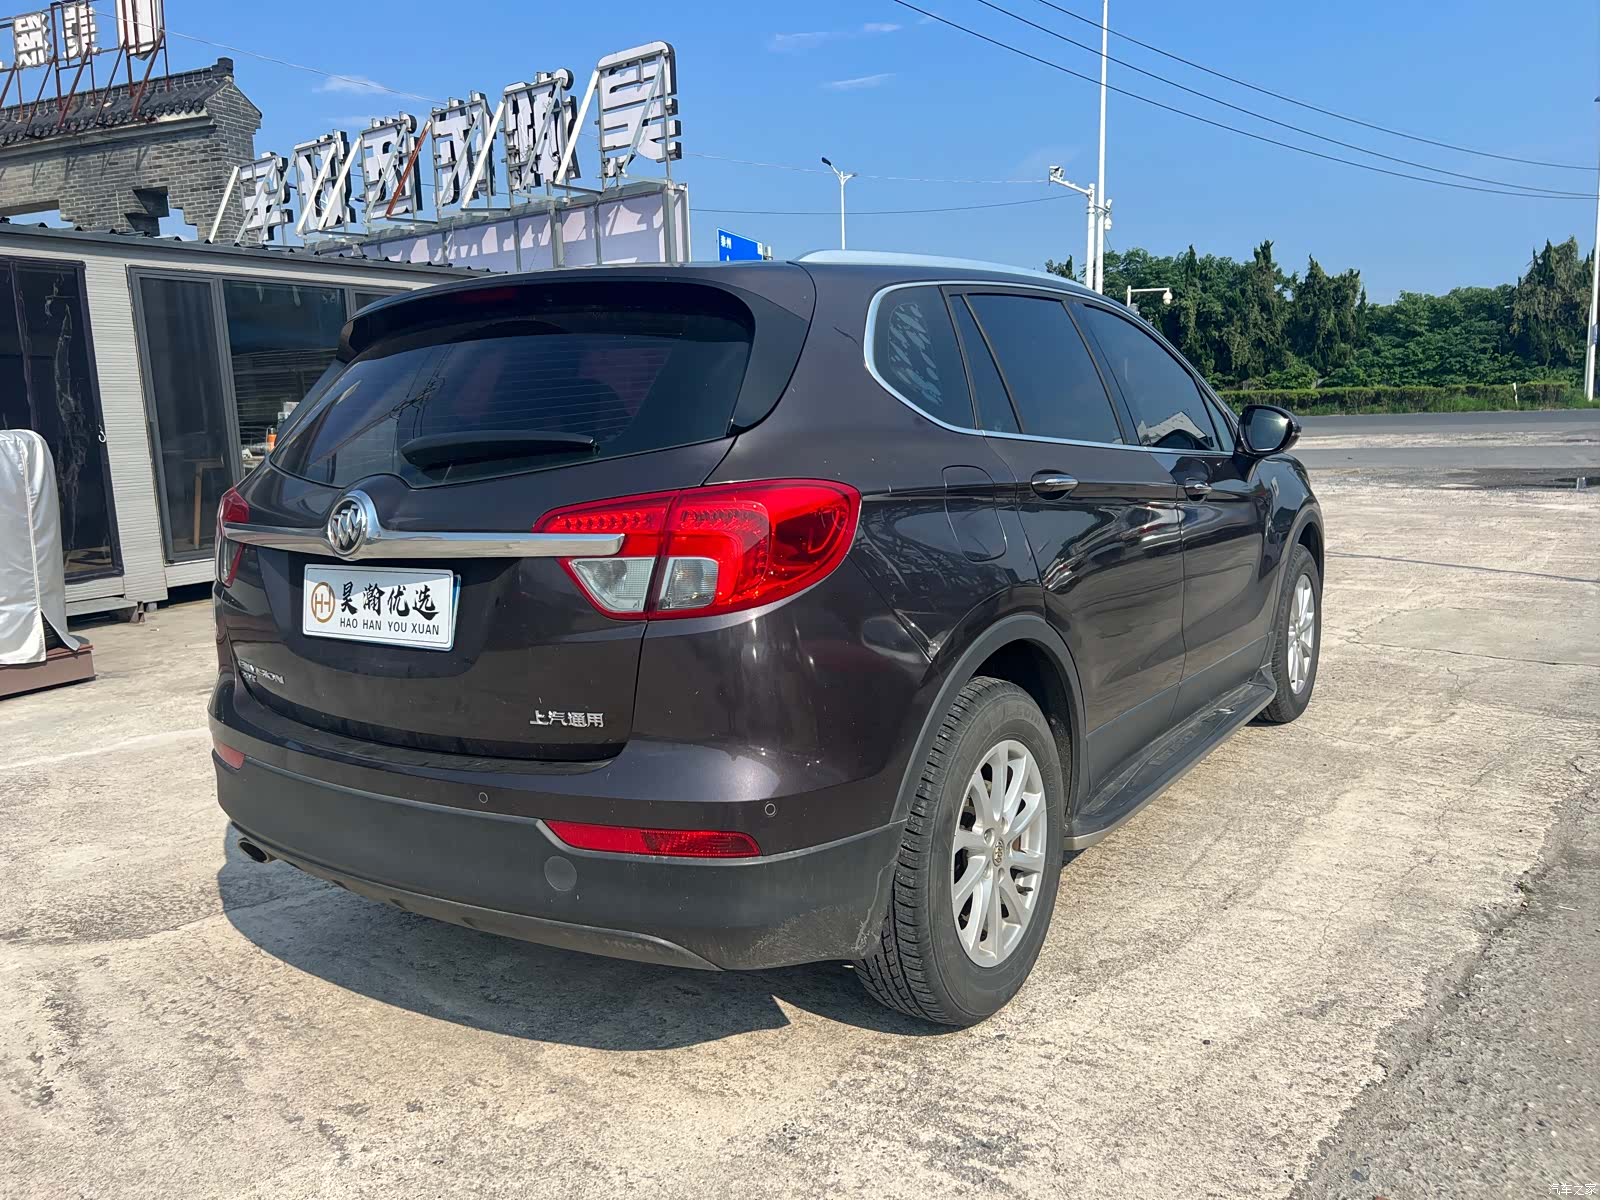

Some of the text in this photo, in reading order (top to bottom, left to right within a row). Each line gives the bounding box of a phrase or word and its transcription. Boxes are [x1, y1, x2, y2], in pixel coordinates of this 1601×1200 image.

[340, 581, 440, 621] 昊瀚优选
[340, 617, 440, 635] HAO HAN YOU XUAN
[529, 710, 604, 728] 上汽通用
